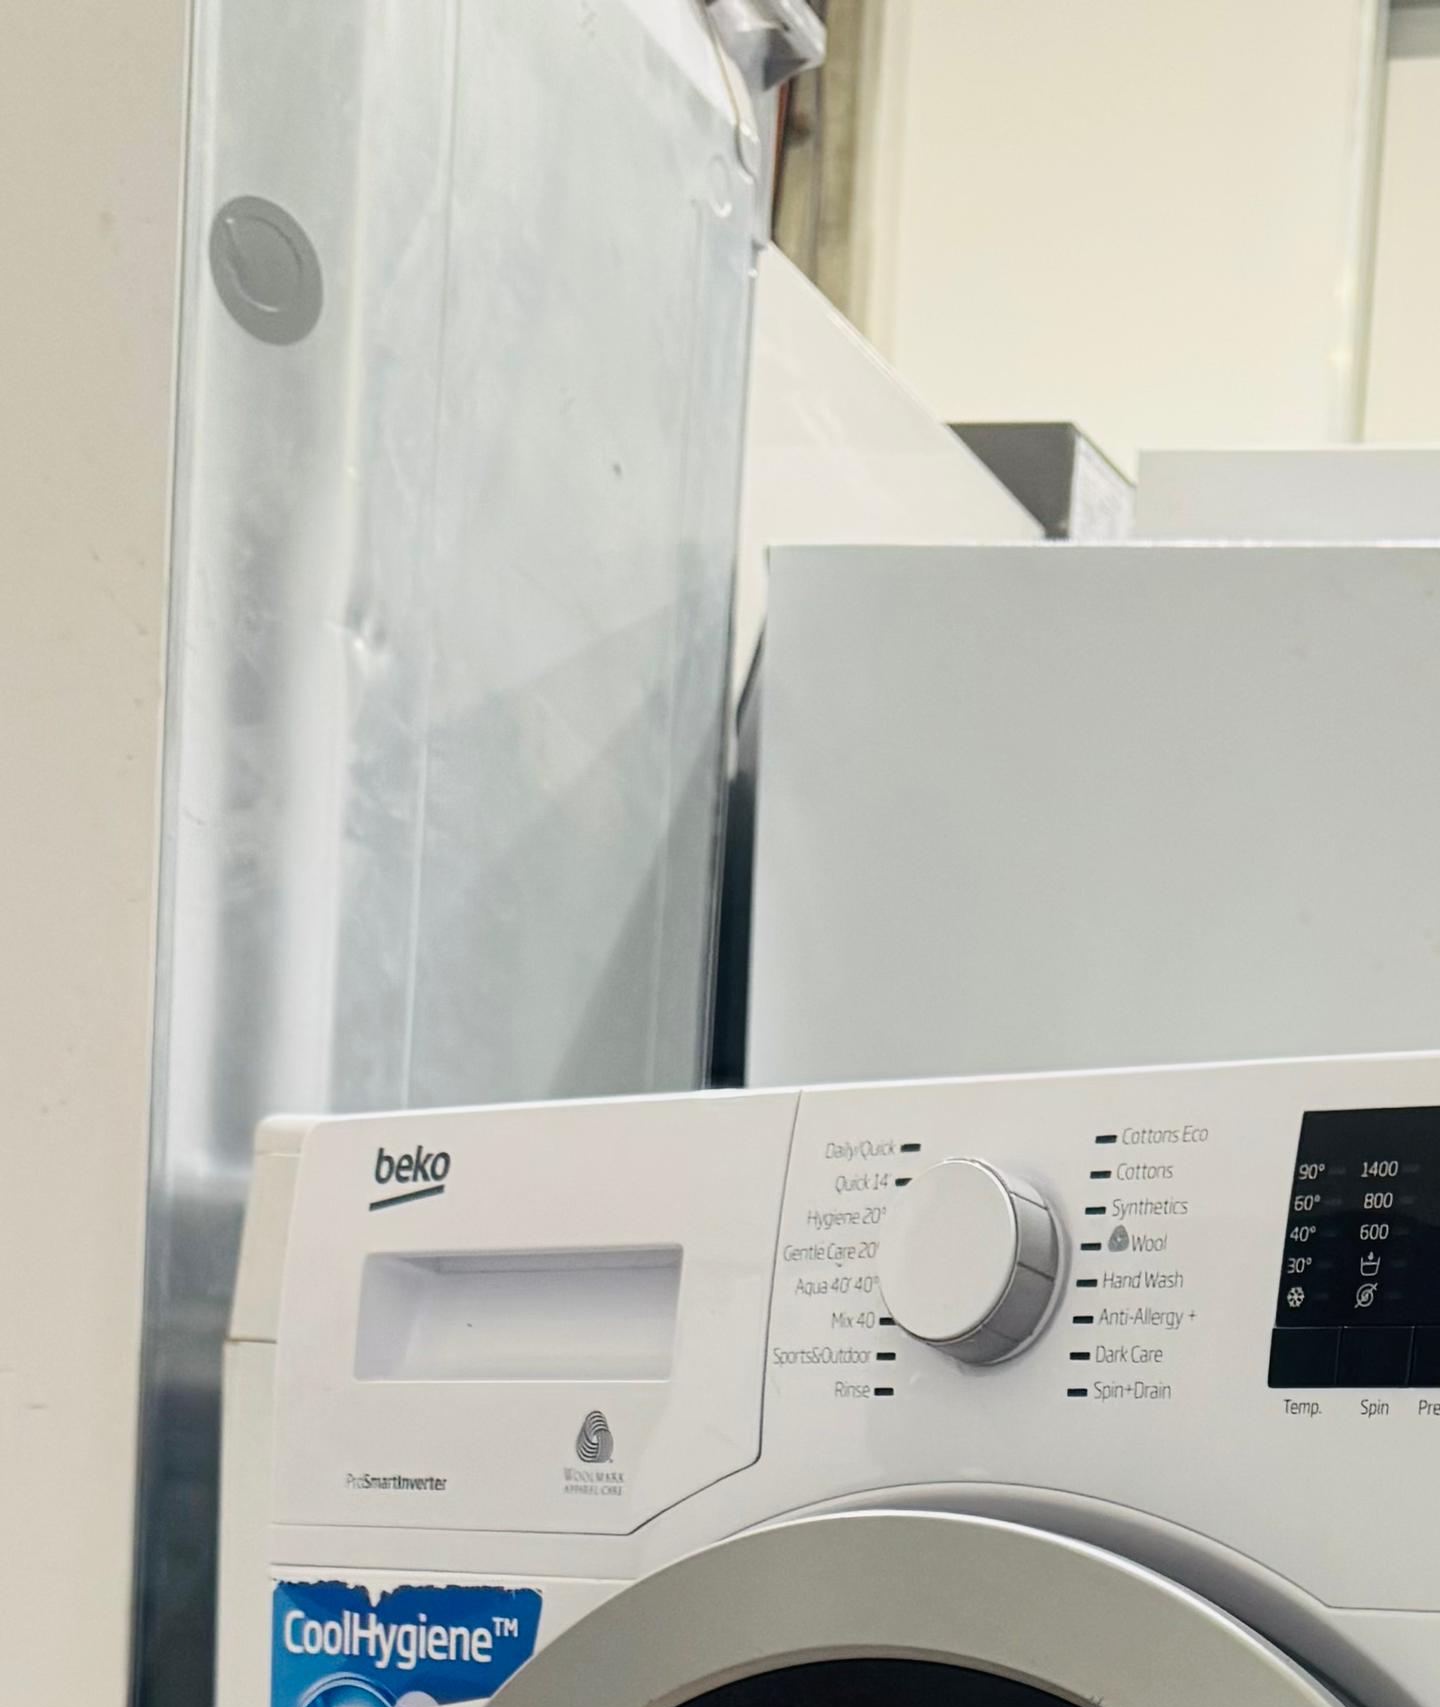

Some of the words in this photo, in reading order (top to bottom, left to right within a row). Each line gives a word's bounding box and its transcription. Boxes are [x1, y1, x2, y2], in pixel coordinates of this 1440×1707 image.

[1121, 1127, 1180, 1146] Cottons
[1182, 1124, 1209, 1143] Eco
[374, 1144, 451, 1184] beko
[1116, 1162, 1174, 1181] Cottons
[1298, 1163, 1326, 1180] 90°
[1360, 1160, 1399, 1178] 1400
[835, 1173, 870, 1195] Quick
[1111, 1197, 1189, 1221] Synthetics
[1293, 1194, 1321, 1212] 60°
[1363, 1192, 1394, 1209] 800
[807, 1209, 860, 1231] Hygiene
[1289, 1225, 1317, 1242] 40°
[1359, 1223, 1390, 1241] 600
[783, 1243, 825, 1263] Gentle
[826, 1241, 856, 1261] Care
[1131, 1234, 1168, 1252] Wool
[1287, 1256, 1313, 1274] 30°
[795, 1278, 828, 1296] Aqua
[1102, 1271, 1141, 1289] Hand
[1144, 1270, 1184, 1289] Wash
[831, 1312, 853, 1329] Mix
[1097, 1307, 1184, 1330] Anti-Allergy
[1188, 1310, 1198, 1320] +
[772, 1347, 872, 1366] Sports&Outdoor
[1095, 1344, 1129, 1364] Dark
[1130, 1344, 1164, 1364] Care
[835, 1380, 871, 1399] Rinse
[1093, 1380, 1172, 1403] Spin+Drain
[1283, 1398, 1323, 1418] Temp.
[1359, 1399, 1390, 1419] Spin
